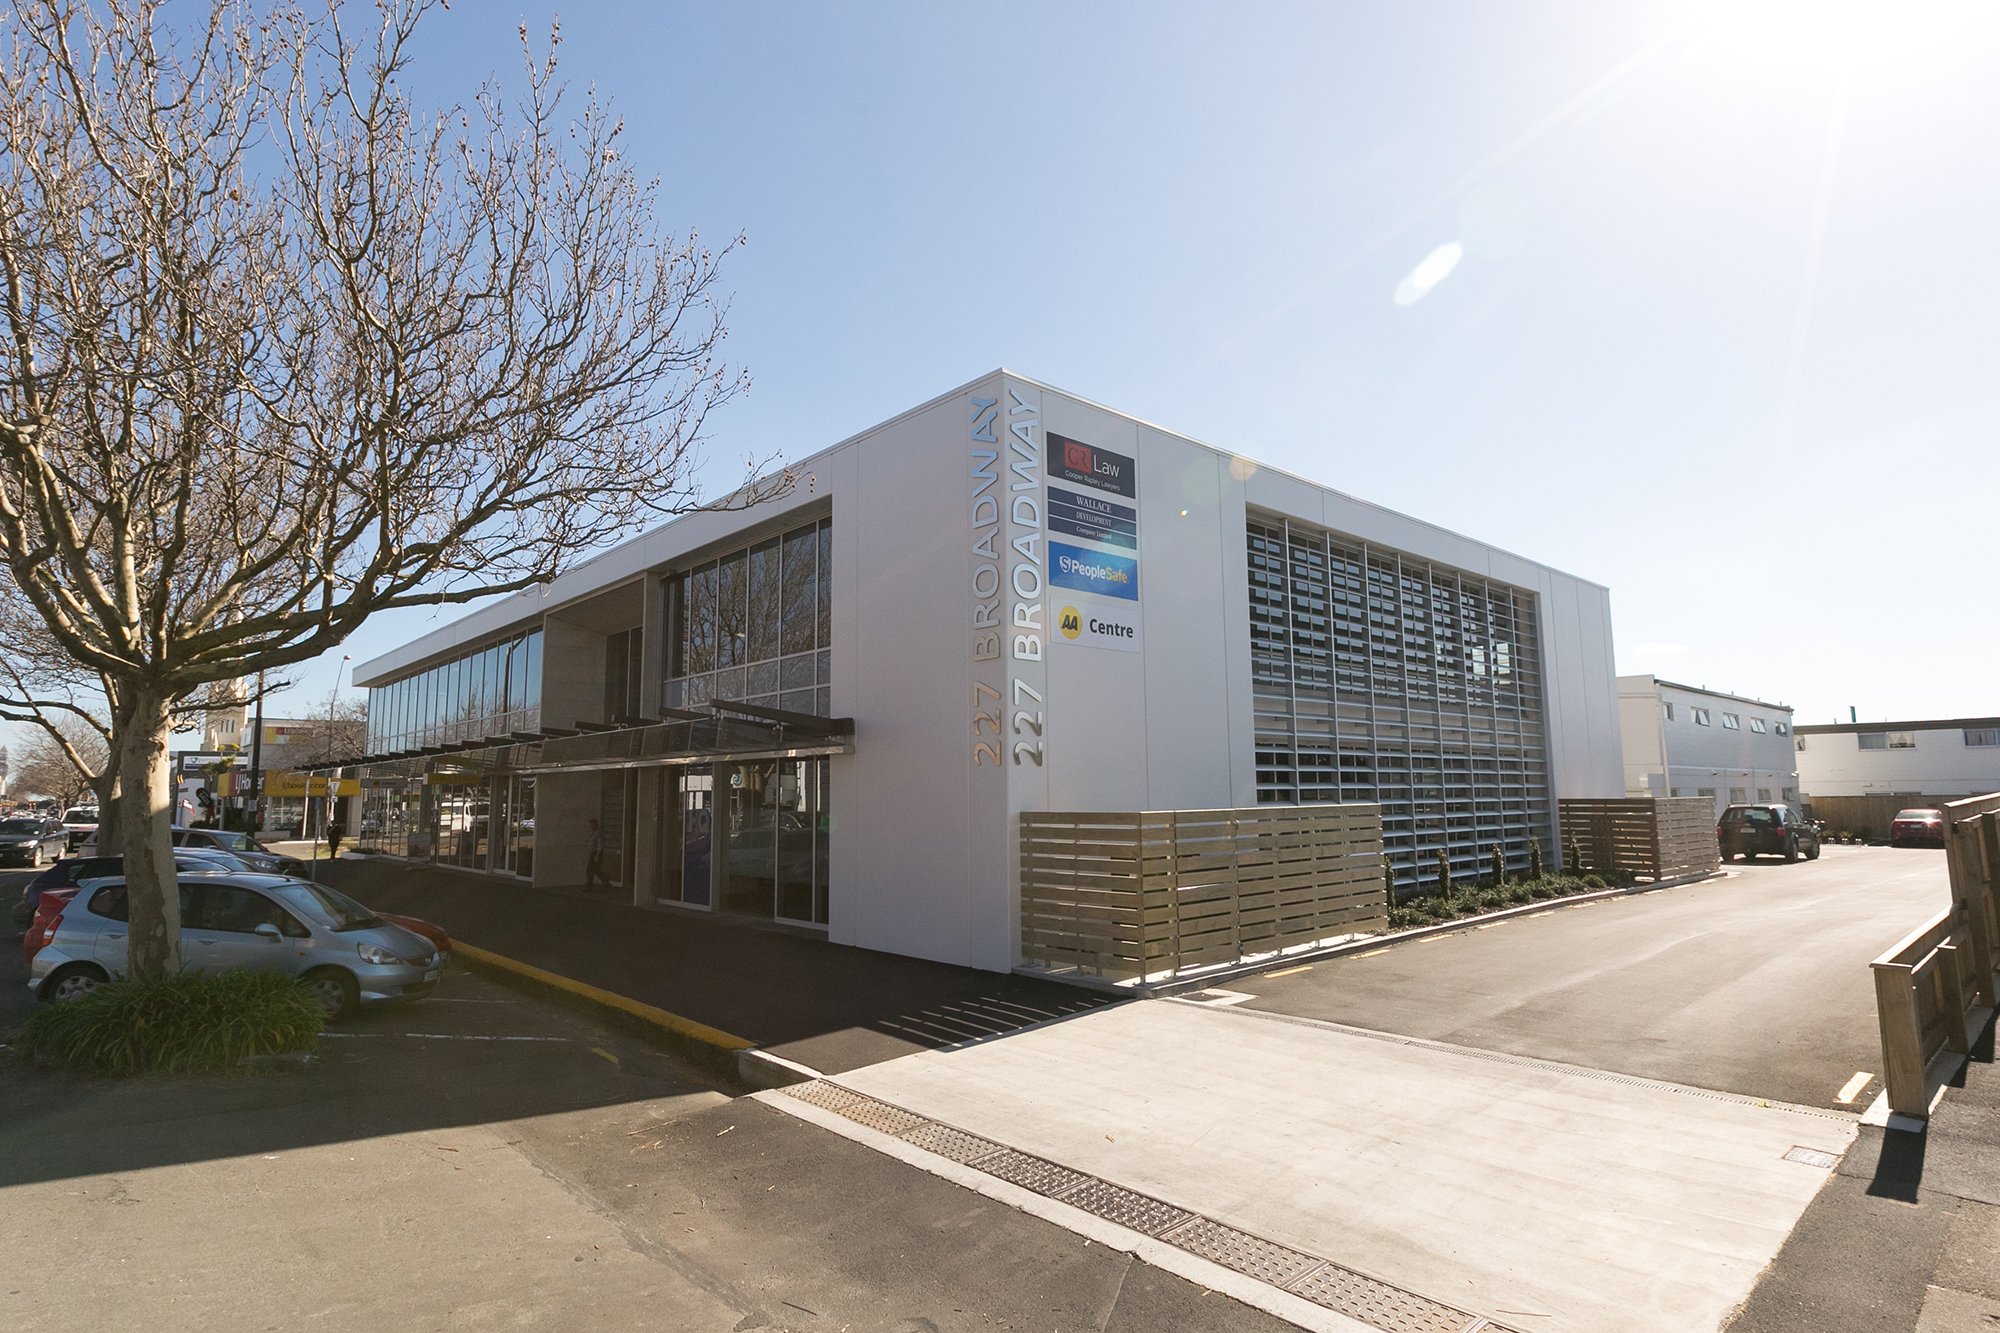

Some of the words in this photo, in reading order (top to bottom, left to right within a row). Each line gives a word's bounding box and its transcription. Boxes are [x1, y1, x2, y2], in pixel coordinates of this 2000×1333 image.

[1093, 454, 1120, 477] Law
[1064, 469, 1083, 481] Cooper
[1100, 480, 1121, 492] Lawyers
[1075, 496, 1112, 514] WALLACE
[971, 395, 1000, 662] BROADWAY
[1009, 388, 1041, 662] BROADWAY
[1076, 511, 1112, 527] DEVELOPMENT
[1076, 526, 1096, 537] Company
[1071, 559, 1128, 584] PeopleSafe
[1061, 614, 1078, 631] AA
[1089, 618, 1134, 638] Centre
[973, 681, 1001, 766] 227
[1013, 678, 1042, 766] 227
